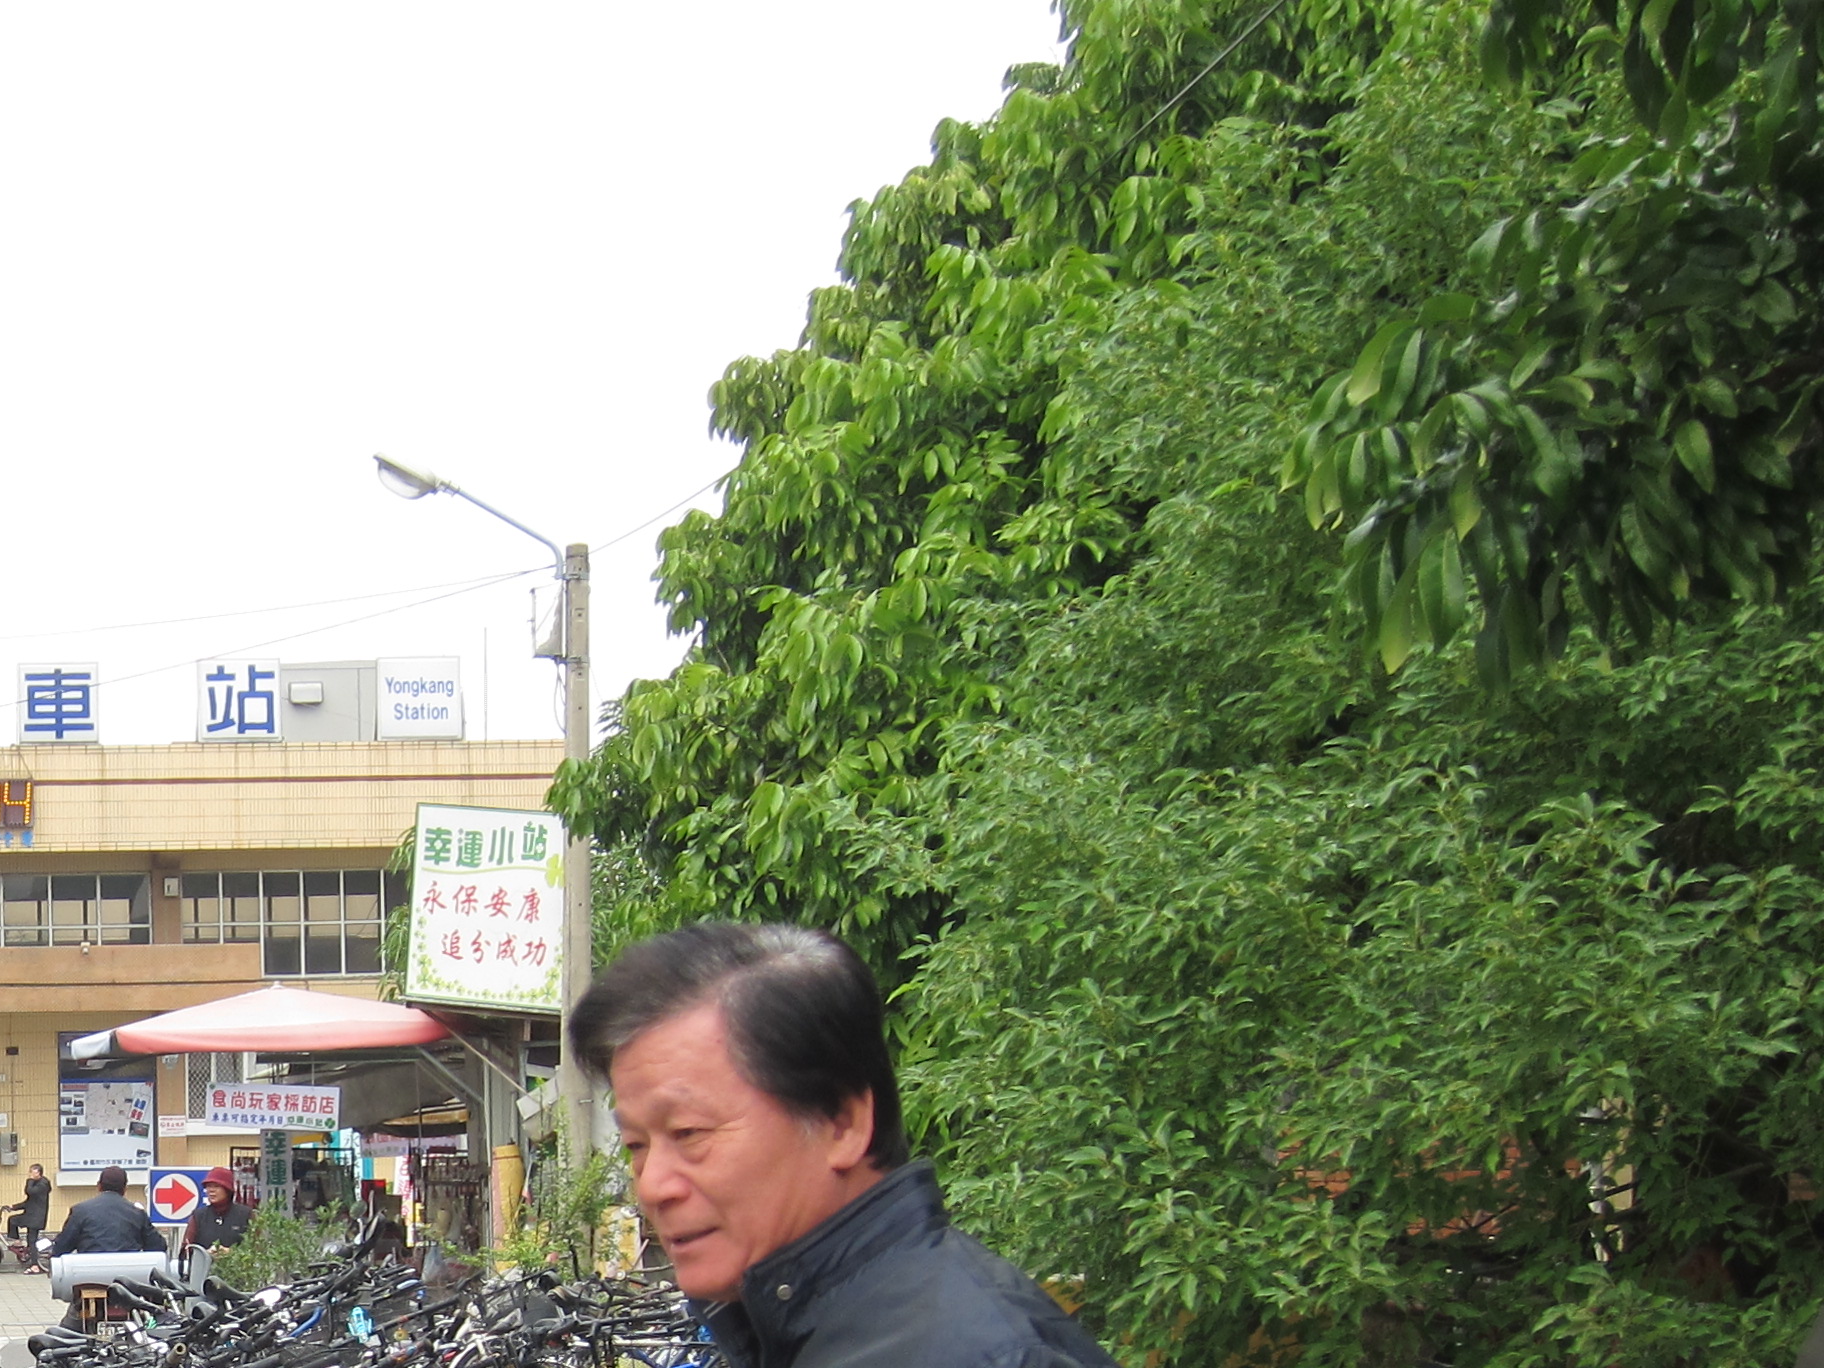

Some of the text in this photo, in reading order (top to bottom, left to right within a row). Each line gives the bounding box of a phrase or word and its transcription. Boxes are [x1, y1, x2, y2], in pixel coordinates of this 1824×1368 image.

[384, 676, 455, 698] Yongkang
[393, 702, 449, 720] Station
[423, 821, 548, 869] 幸運小站
[422, 880, 541, 924] 永保安康
[440, 928, 547, 967] 追分成功
[212, 1089, 335, 1114] 食尚玩家採訪店
